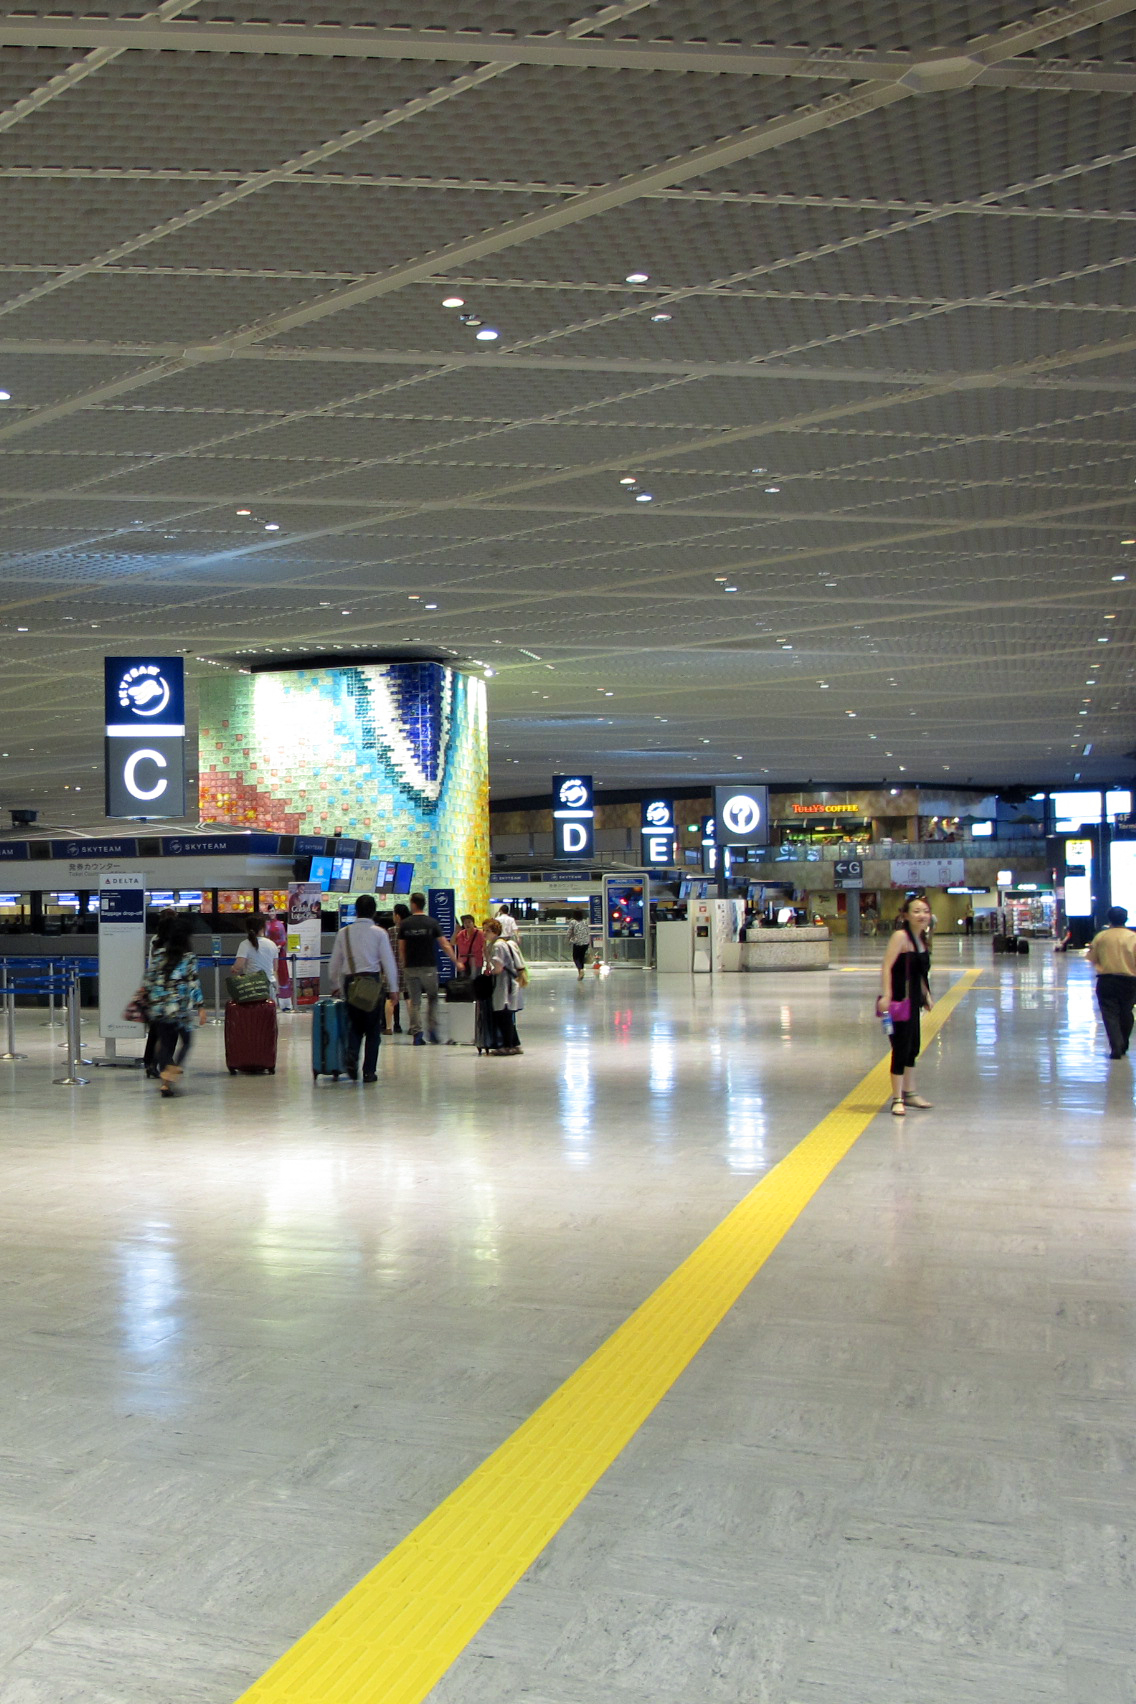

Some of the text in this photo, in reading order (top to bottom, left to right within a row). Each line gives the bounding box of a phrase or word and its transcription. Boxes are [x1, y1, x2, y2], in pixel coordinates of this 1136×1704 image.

[123, 748, 168, 801] C
[825, 804, 859, 812] COFFEE
[1118, 813, 1131, 822] 4F
[562, 822, 587, 852] D
[649, 837, 668, 862] E
[849, 861, 860, 874] G
